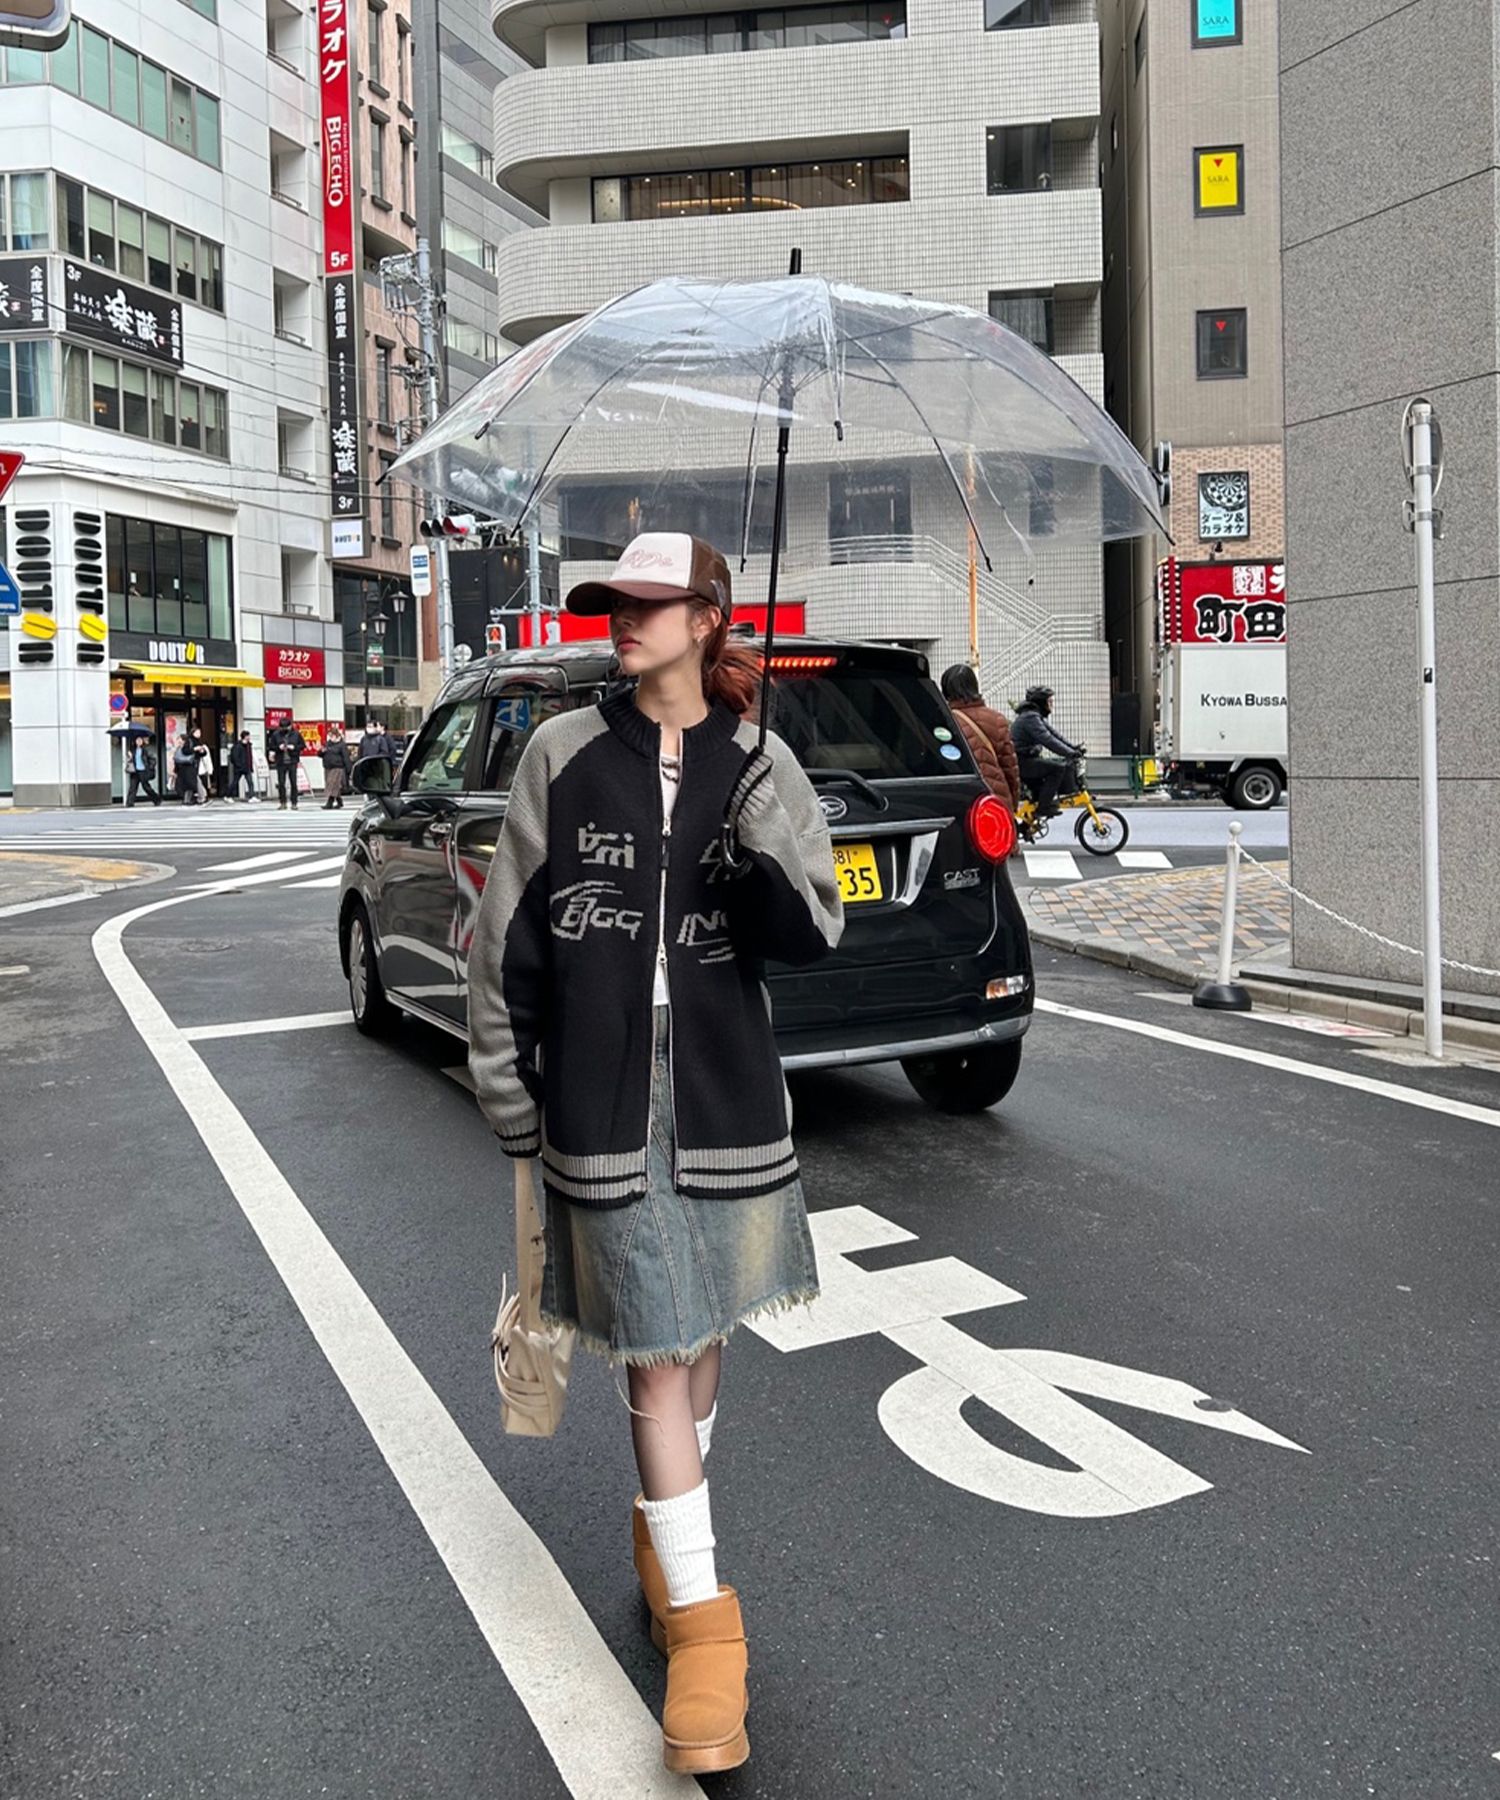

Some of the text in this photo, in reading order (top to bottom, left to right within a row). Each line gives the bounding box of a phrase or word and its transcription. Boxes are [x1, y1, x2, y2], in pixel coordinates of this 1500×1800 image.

[1202, 16, 1230, 26] SARA
[322, 0, 346, 84] ラオケ
[326, 115, 344, 207] BIG ECHO
[330, 251, 349, 267] 5F
[67, 264, 82, 281] 3F
[338, 495, 354, 509] 3F
[1202, 523, 1245, 535] カラオケ
[1194, 594, 1287, 643] 町田
[148, 640, 205, 665] DOUTOR
[279, 649, 311, 663] カラオケ
[1201, 693, 1243, 707] KYOWA
[943, 867, 981, 881] CAST
